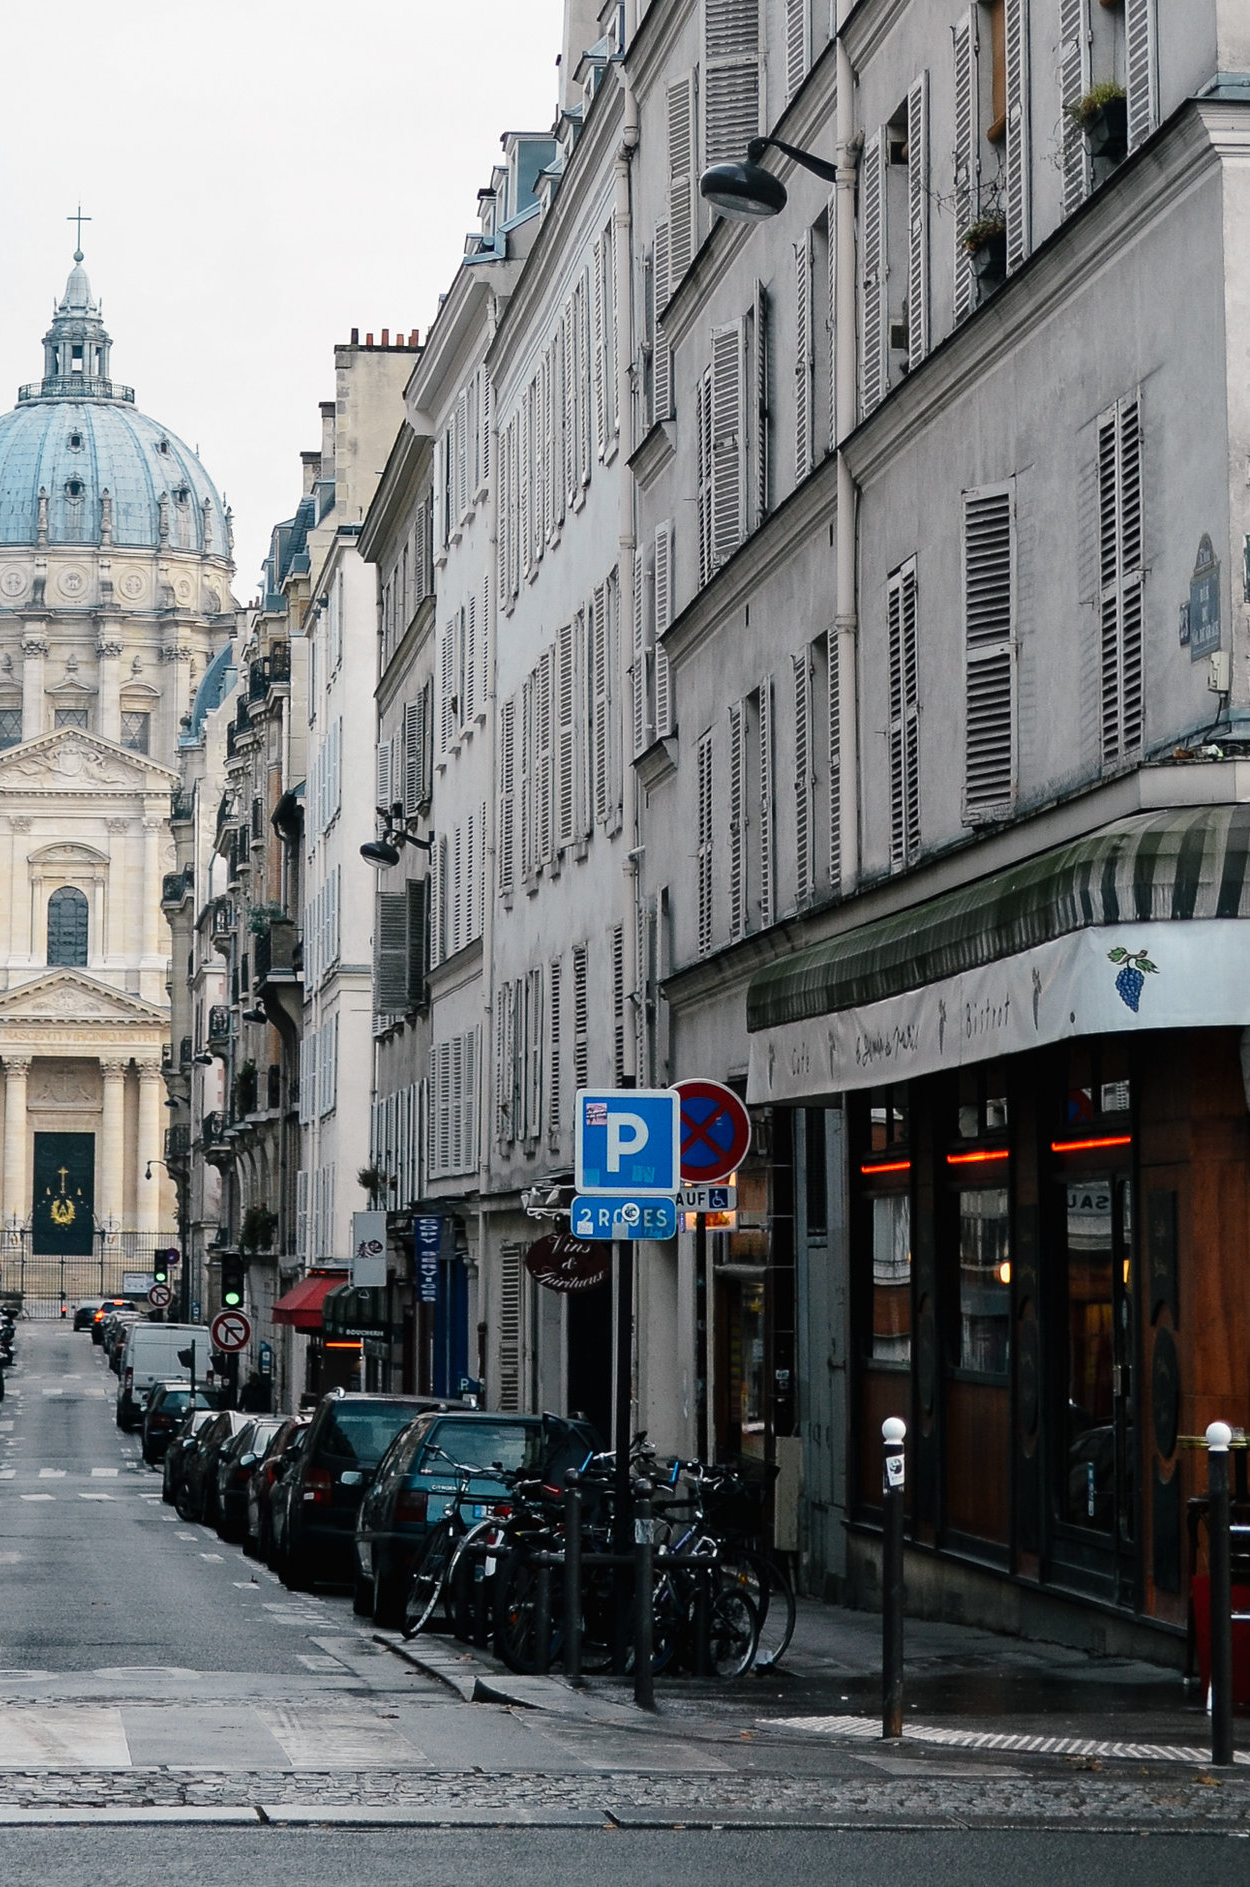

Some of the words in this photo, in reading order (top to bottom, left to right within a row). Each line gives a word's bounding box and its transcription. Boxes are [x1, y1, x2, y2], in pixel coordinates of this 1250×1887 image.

[606, 1112, 649, 1173] P
[676, 1192, 706, 1206] AUF
[580, 1208, 592, 1224] 2
